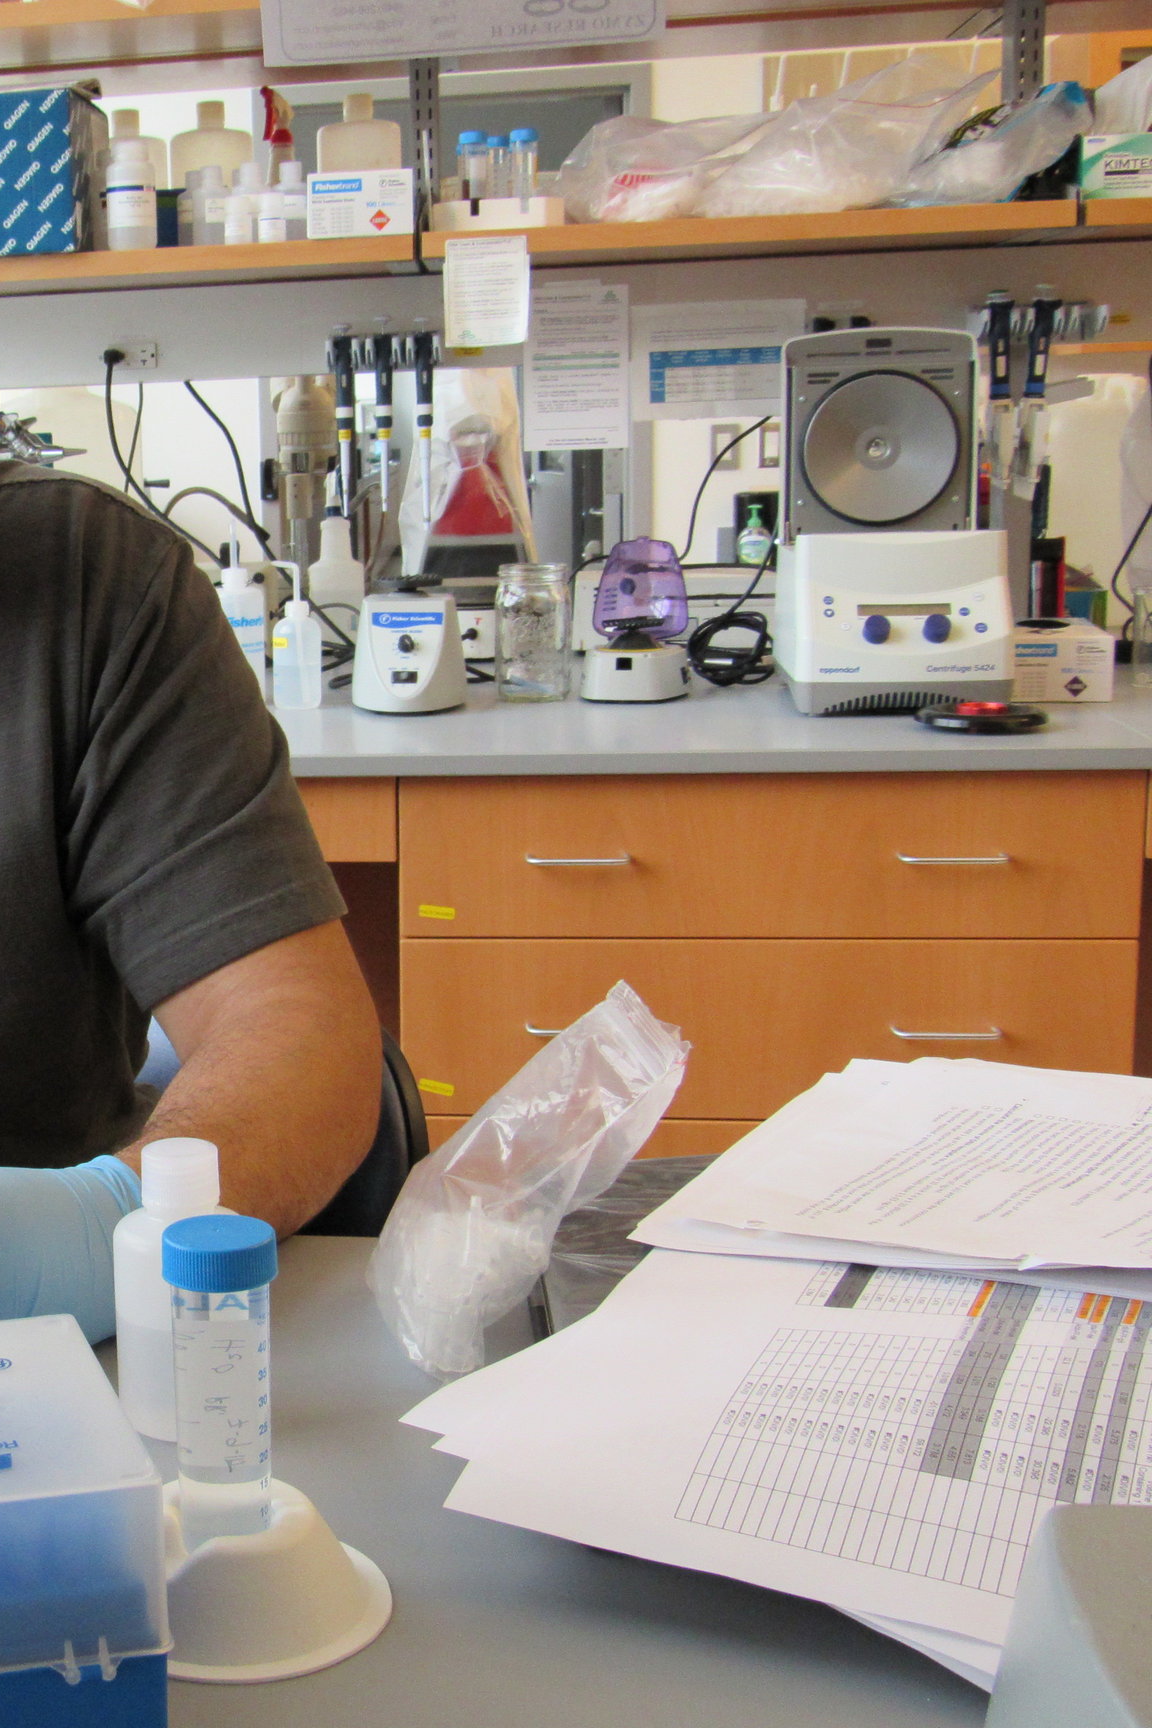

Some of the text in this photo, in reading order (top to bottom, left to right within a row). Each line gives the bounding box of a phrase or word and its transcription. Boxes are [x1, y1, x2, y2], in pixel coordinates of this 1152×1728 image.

[3, 99, 30, 130] QIAGEN
[27, 122, 54, 152] QIAGEN
[3, 199, 28, 229] QIAGEN
[26, 220, 52, 250] QIAGEN
[819, 665, 860, 675] eppendorf
[926, 664, 996, 673] Centrifuge 5424
